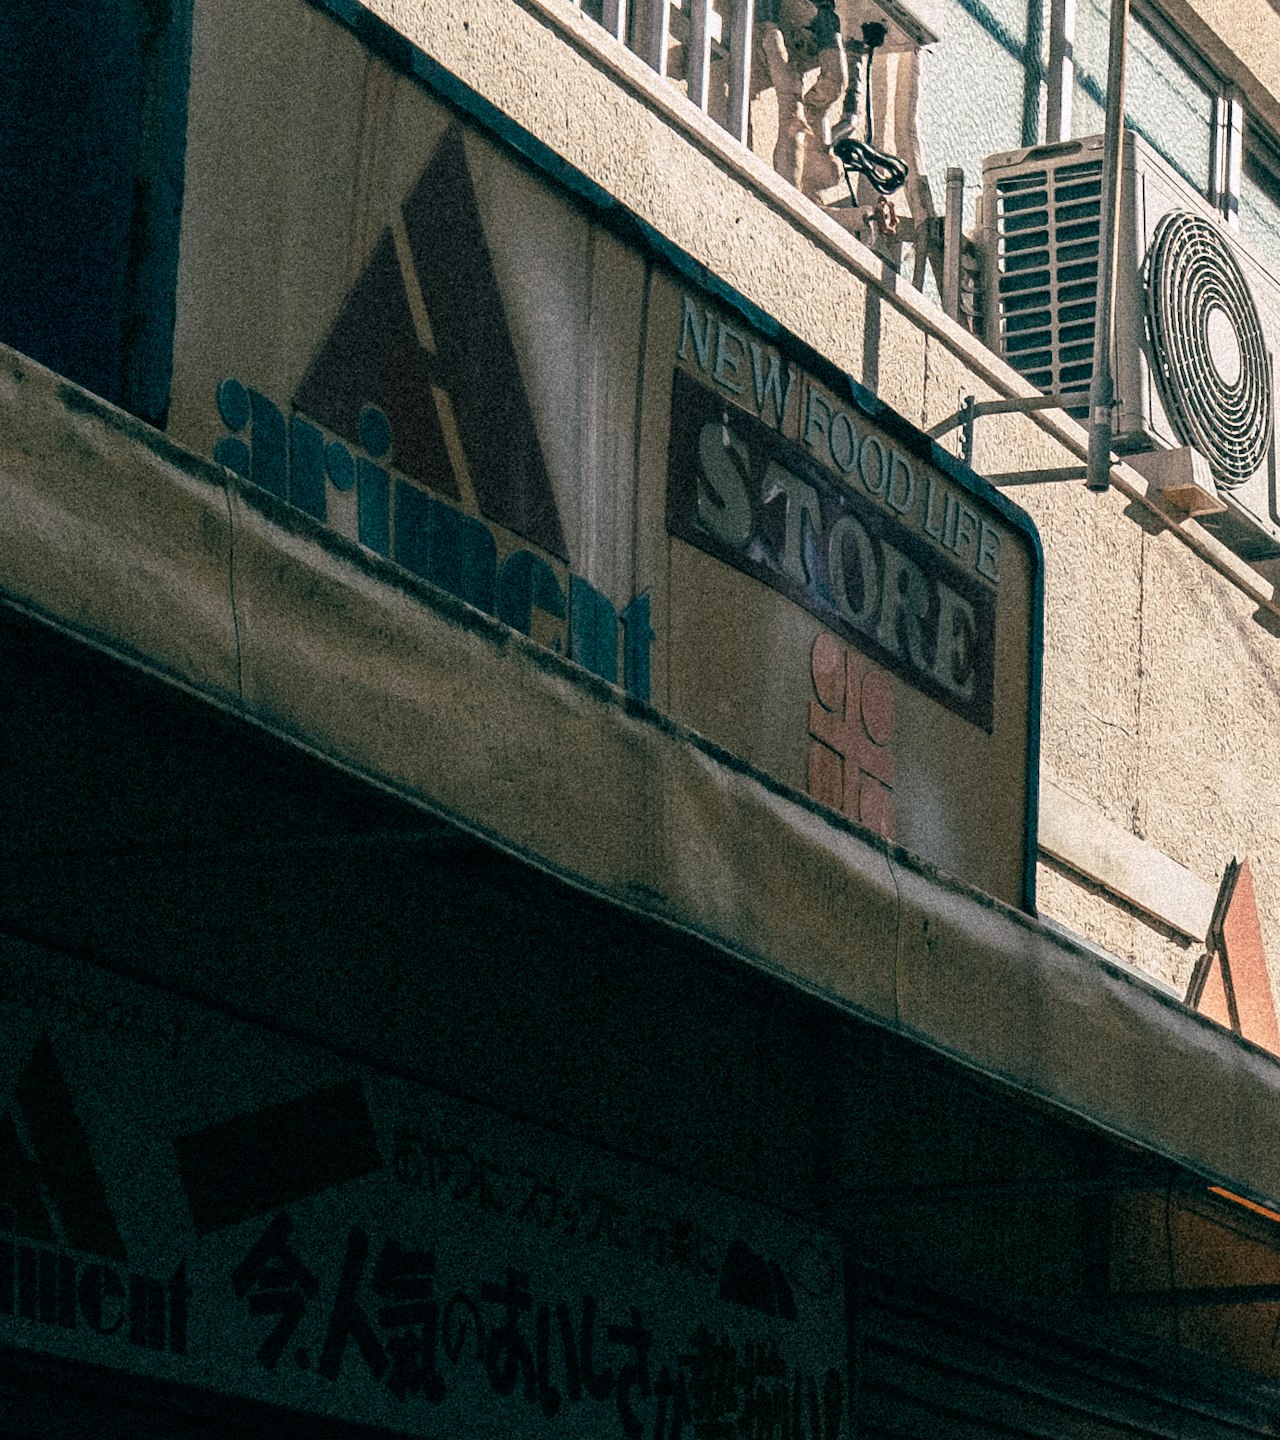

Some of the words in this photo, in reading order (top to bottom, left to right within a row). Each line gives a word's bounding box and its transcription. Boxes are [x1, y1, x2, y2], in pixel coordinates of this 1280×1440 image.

[677, 294, 800, 431] NEW
[801, 371, 914, 513] FOOD
[922, 453, 1003, 583] LIFE
[695, 418, 979, 709] STORE
